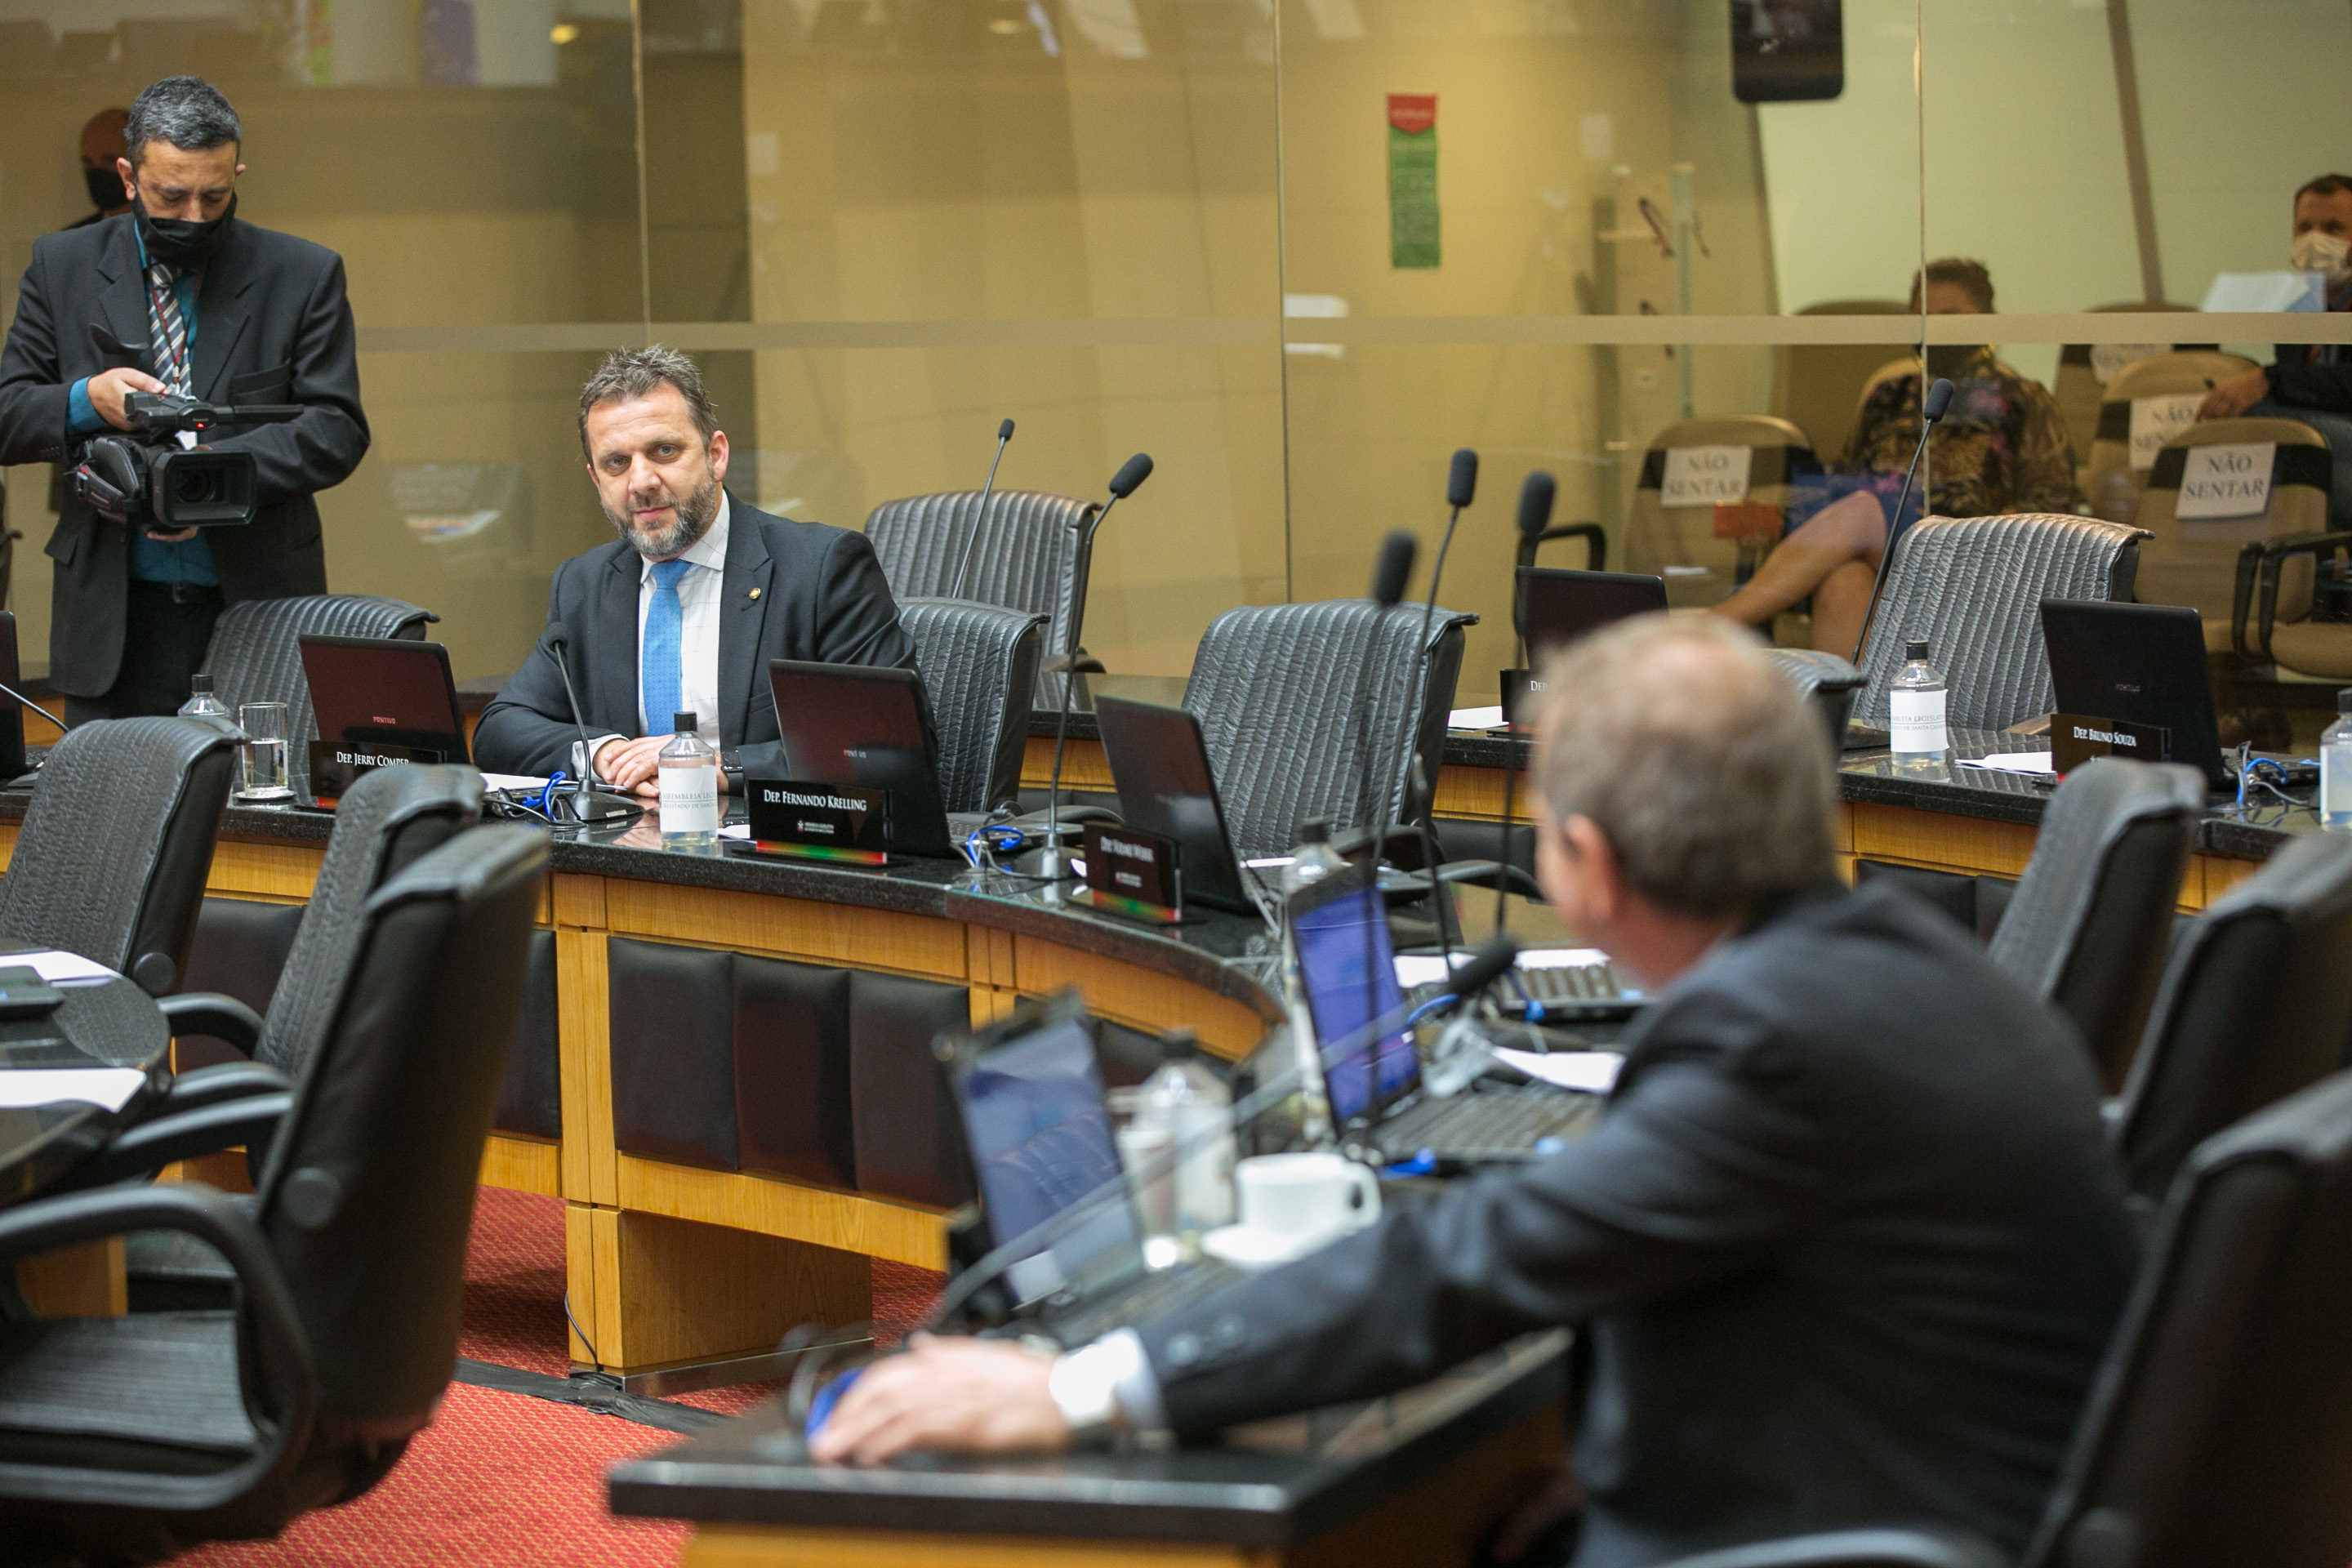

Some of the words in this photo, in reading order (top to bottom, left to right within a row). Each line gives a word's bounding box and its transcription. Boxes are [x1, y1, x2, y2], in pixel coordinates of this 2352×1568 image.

[2207, 452, 2252, 475] NÃO
[2185, 479, 2265, 500] SENTAR
[2088, 728, 2113, 743] BRUNO
[2114, 732, 2136, 746] SOUZA
[336, 751, 353, 764] DEP.
[354, 753, 376, 766] JERRY
[764, 789, 781, 803] DEP.
[782, 791, 826, 808] FERNANDO
[827, 795, 867, 812] KRELLING
